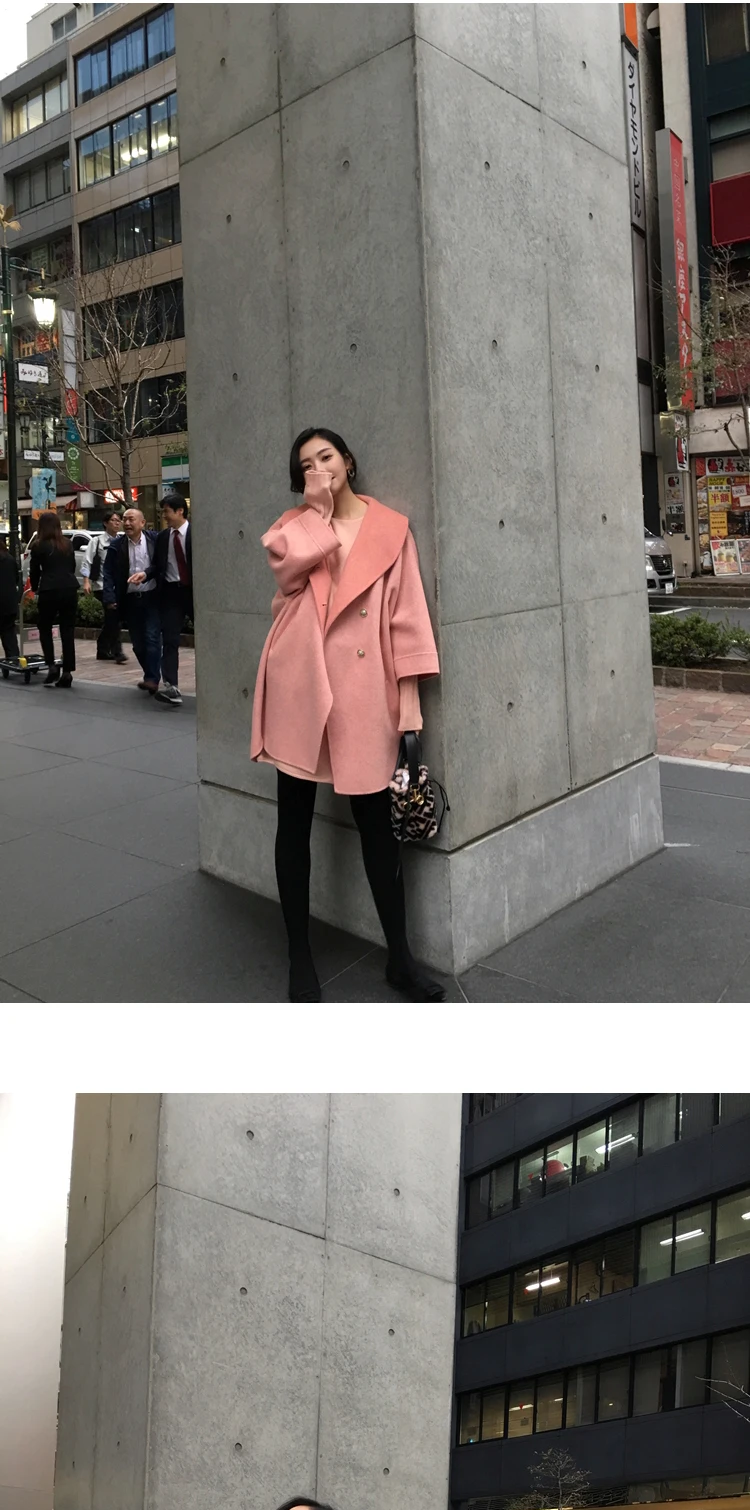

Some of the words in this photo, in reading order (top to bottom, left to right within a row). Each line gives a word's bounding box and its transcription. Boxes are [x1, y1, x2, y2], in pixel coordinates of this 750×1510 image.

[627, 61, 642, 218] ダイヤモンドビル
[711, 493, 730, 504] 半額
